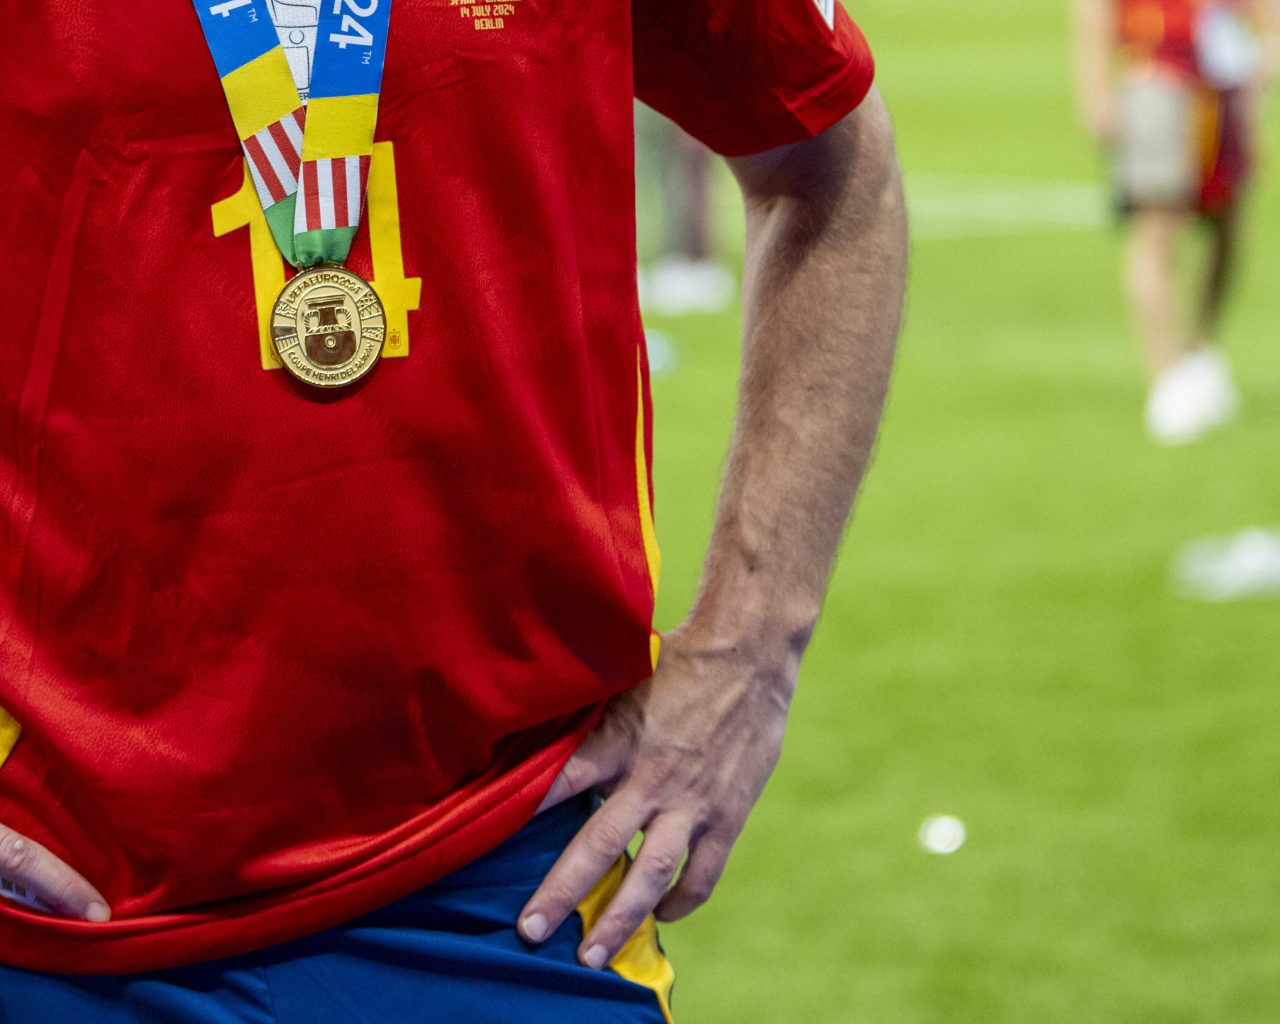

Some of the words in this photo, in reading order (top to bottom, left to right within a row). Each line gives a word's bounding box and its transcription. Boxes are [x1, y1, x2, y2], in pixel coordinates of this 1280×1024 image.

[460, 6, 470, 18] 14
[471, 4, 491, 17] JULY
[492, 4, 515, 16] 2024
[474, 17, 504, 30] BERLIN
[287, 351, 312, 375] COUPE
[313, 370, 339, 381] HENRI
